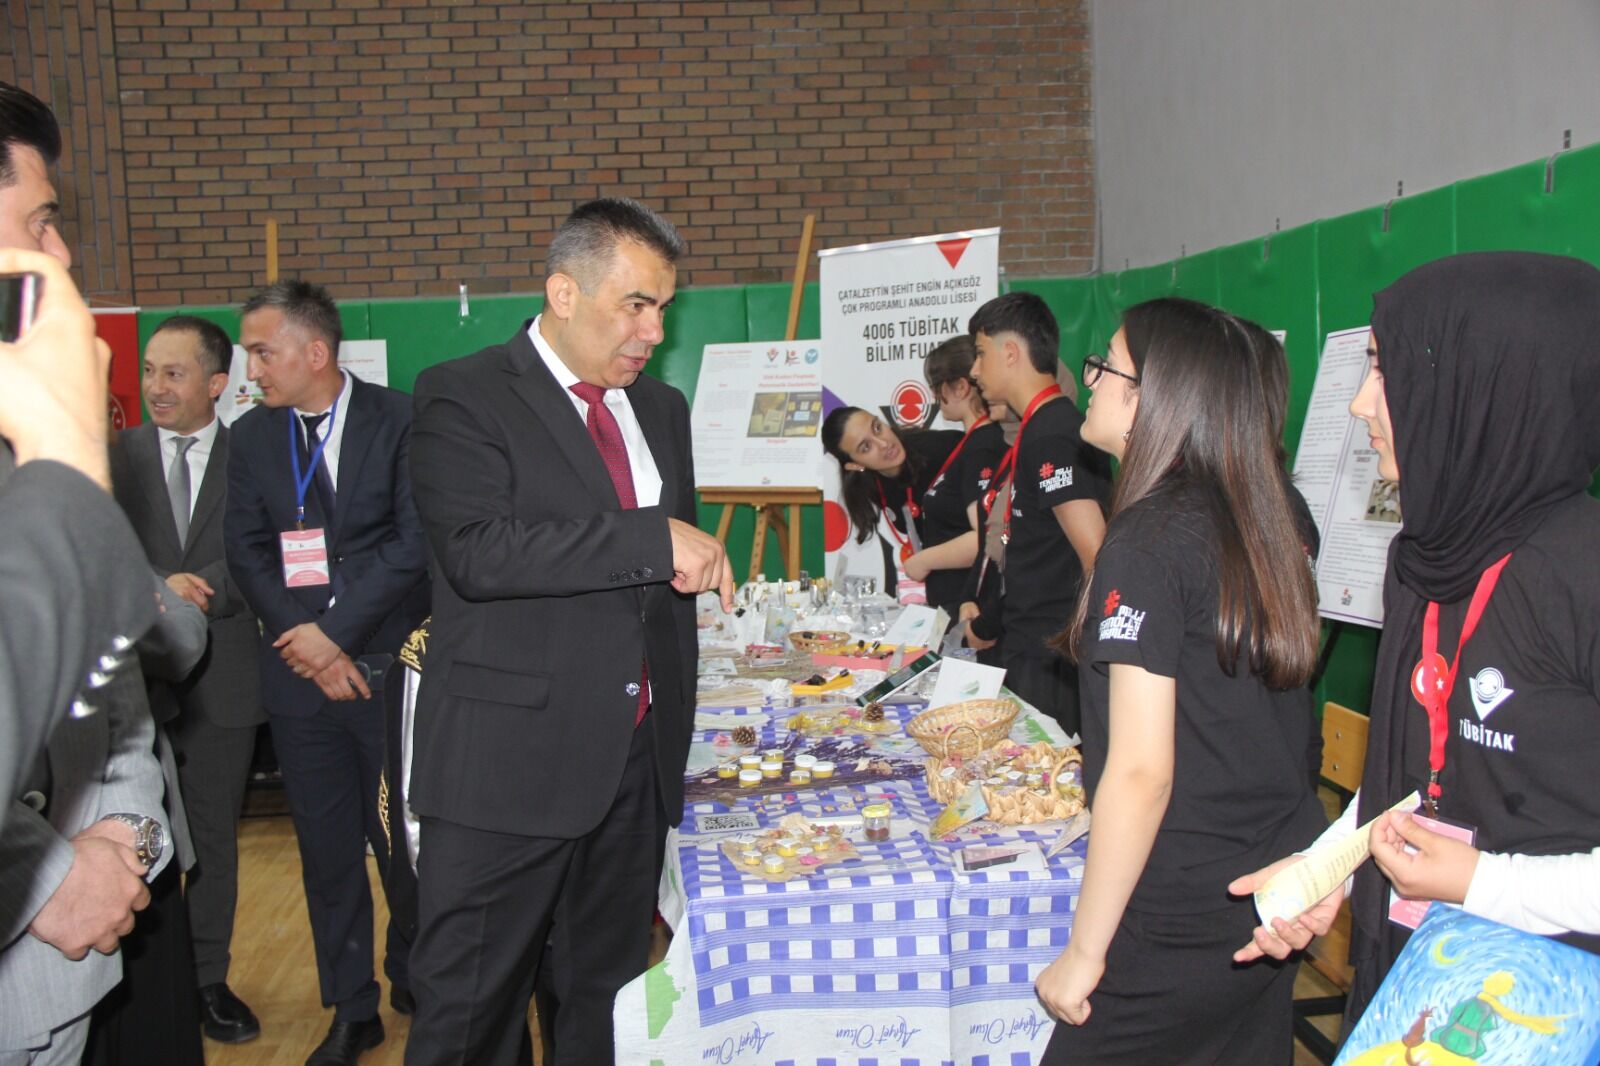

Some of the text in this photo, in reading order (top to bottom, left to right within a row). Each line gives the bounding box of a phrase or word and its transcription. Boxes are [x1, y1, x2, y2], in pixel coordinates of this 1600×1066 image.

[838, 275, 981, 303] ÇATALZEYTİN ŞEHİT ENGİN AÇIKGÖZ
[842, 290, 977, 317] ÇOK PROGRAMLI ANADOLU LİSESİ
[862, 315, 960, 341] 4006 TÜBİTAK
[866, 341, 942, 363] BİLİM FUA
